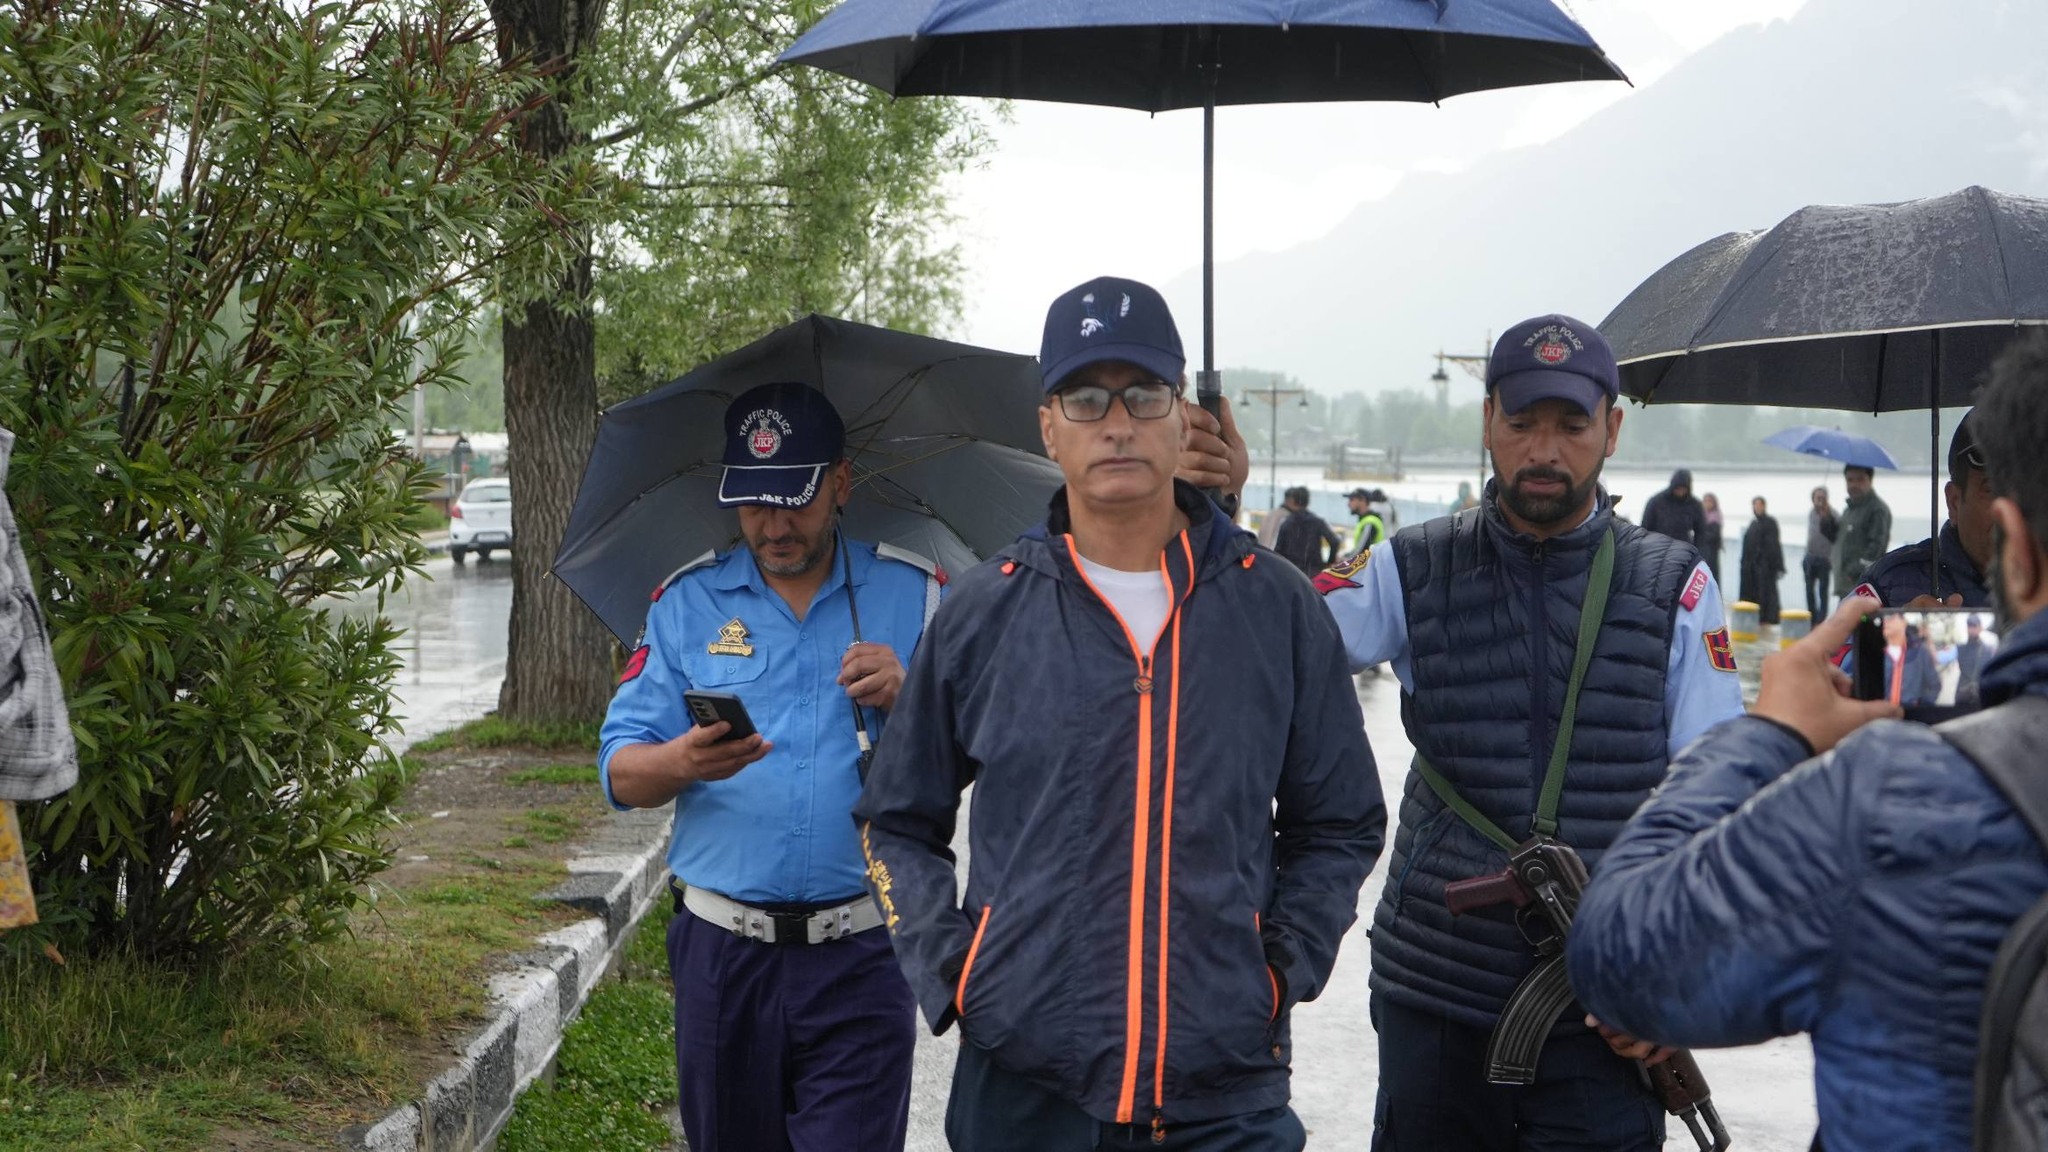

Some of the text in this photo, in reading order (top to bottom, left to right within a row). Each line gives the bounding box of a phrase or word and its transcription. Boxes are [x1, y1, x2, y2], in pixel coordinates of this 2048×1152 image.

[1523, 325, 1584, 351] TRAFFIC POLICE
[1541, 346, 1564, 357] JKP
[739, 409, 793, 436] TRAFFIC POLICE
[755, 437, 774, 448] JKP
[759, 482, 816, 506] J&K POLICE
[1690, 573, 1706, 599] JKP
